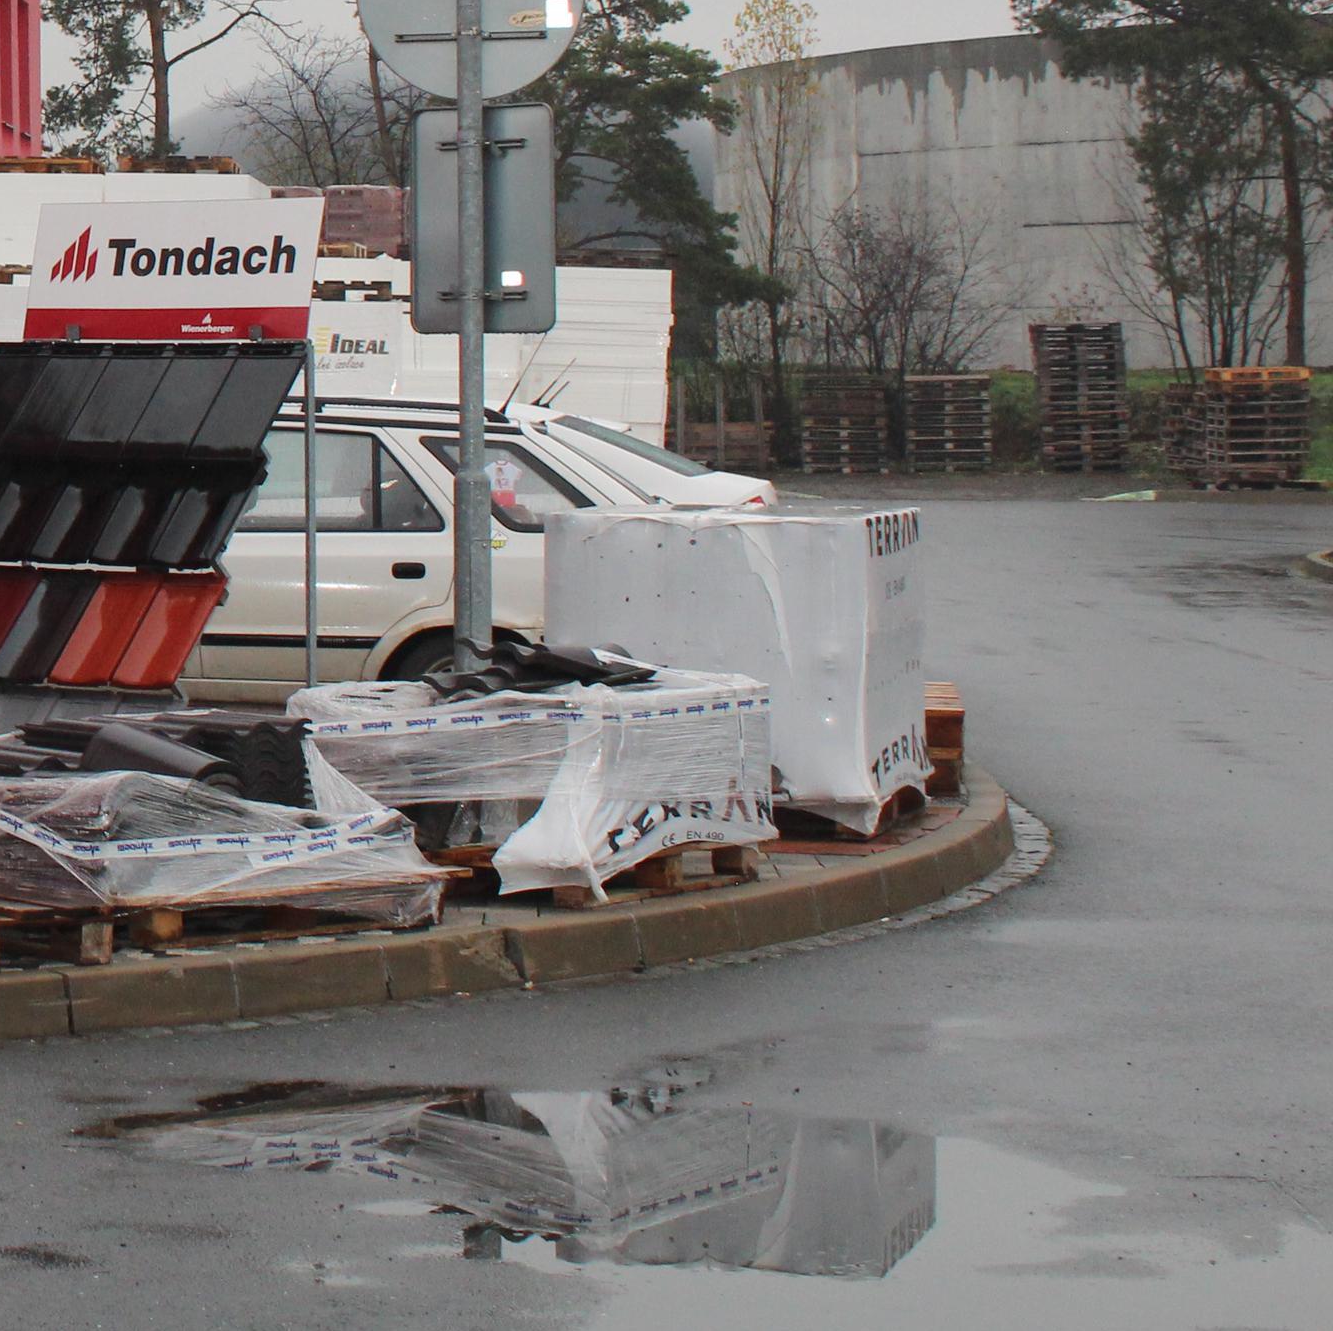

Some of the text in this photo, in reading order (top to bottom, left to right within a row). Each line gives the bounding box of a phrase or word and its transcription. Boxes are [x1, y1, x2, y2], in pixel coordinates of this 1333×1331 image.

[108, 235, 296, 277] Tondach
[180, 324, 235, 334] Wienerberger
[865, 510, 920, 559] TERRAN
[871, 724, 934, 789] TERRAN
[686, 830, 702, 840] EN
[705, 831, 725, 841] 490
